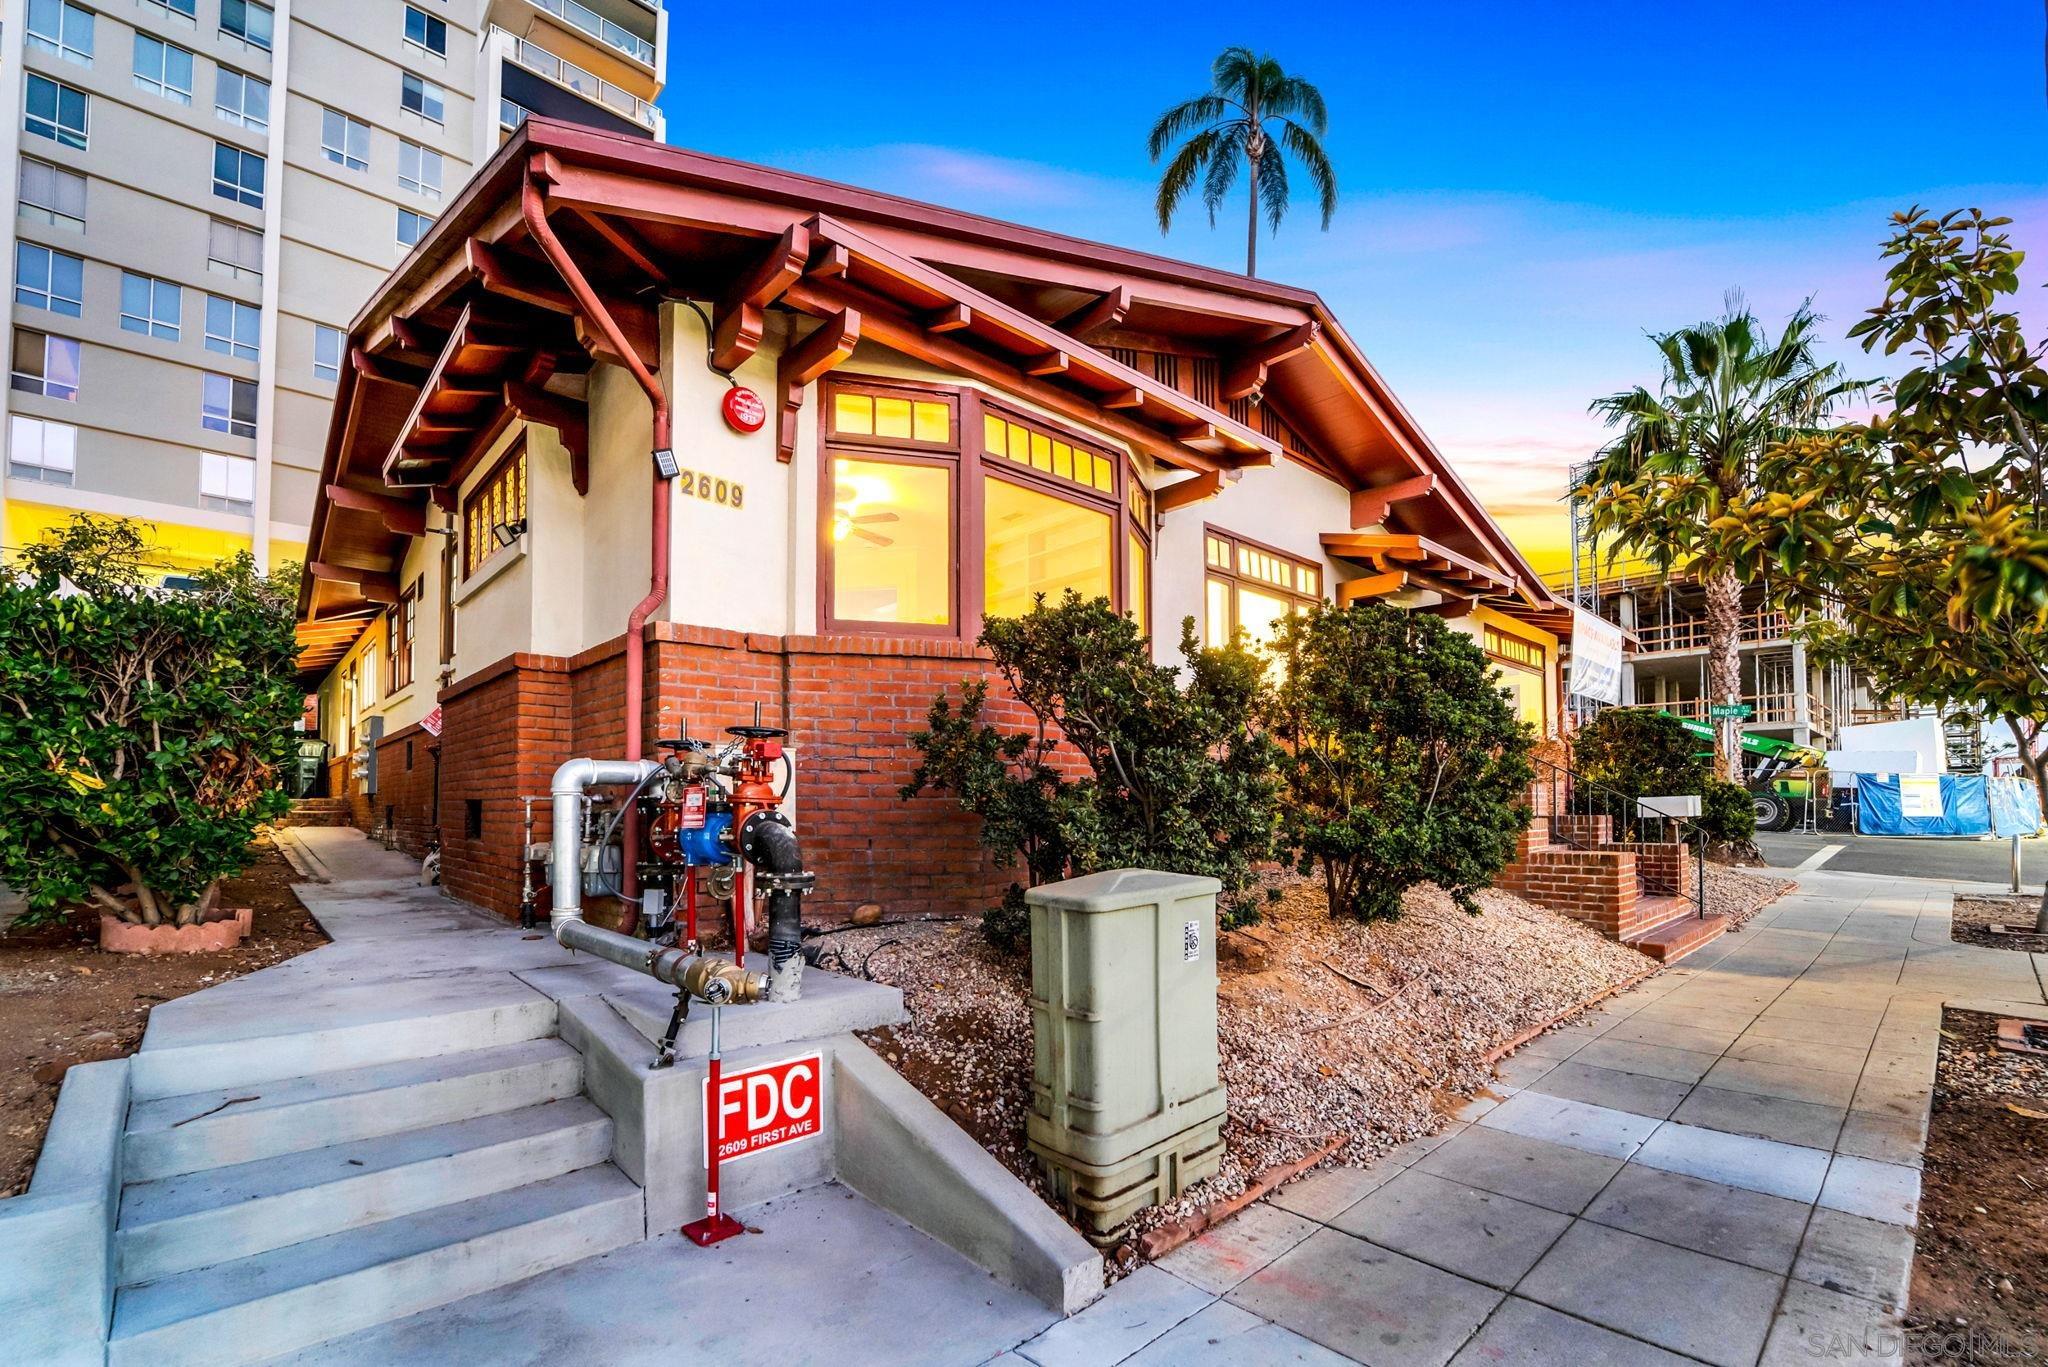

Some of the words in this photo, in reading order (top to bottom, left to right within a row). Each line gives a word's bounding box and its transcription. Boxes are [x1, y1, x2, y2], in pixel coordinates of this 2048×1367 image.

[681, 470, 744, 508] 2609
[1681, 722, 1716, 736] SUNBEL
[1712, 706, 1738, 717] Maple
[718, 1064, 813, 1140] FDC
[718, 1140, 747, 1156] 2609
[750, 1127, 787, 1147] FIRST
[788, 1119, 813, 1136] AVE
